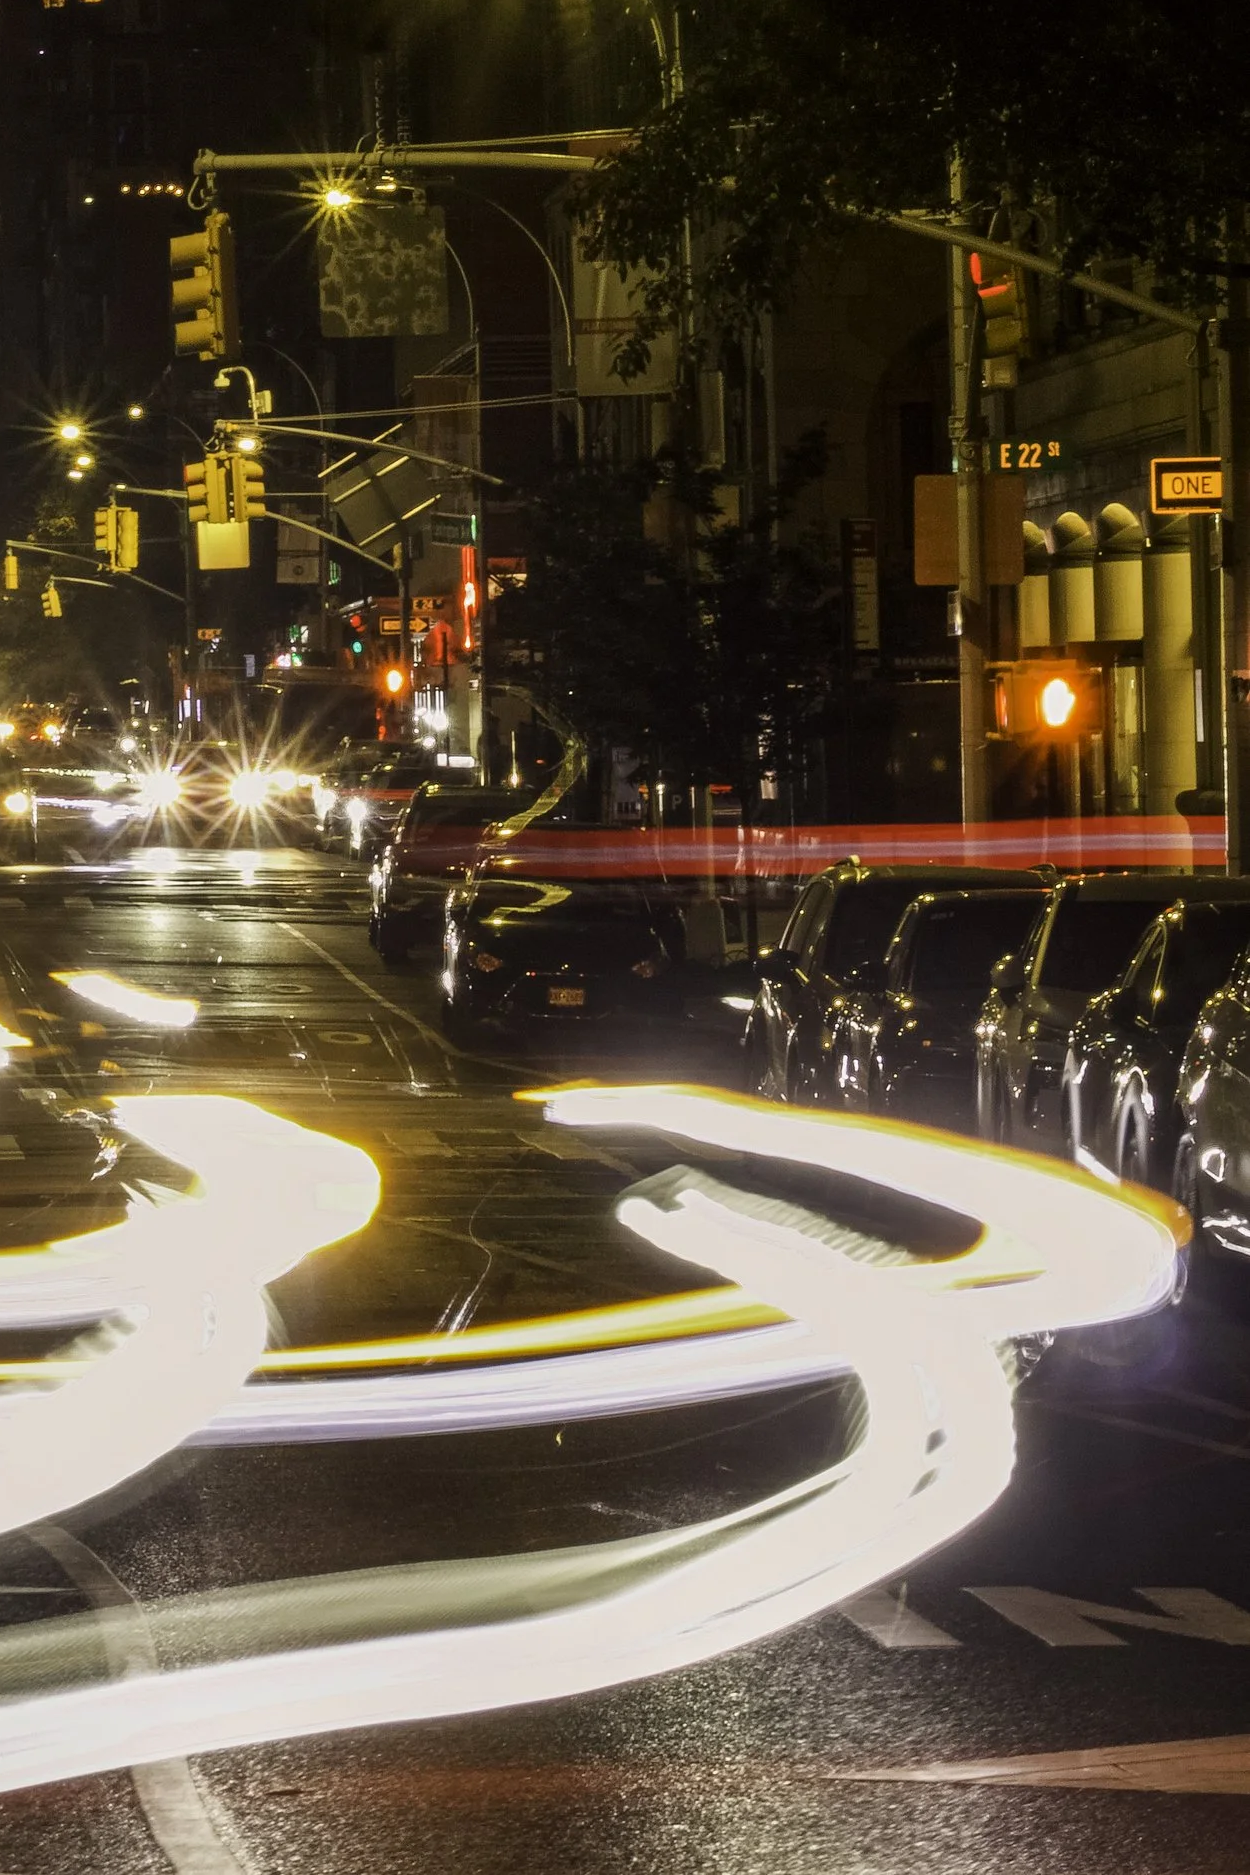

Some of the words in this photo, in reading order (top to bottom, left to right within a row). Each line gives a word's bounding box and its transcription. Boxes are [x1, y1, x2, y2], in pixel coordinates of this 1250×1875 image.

[1000, 443, 1012, 468] E
[1018, 443, 1042, 468] 22
[1171, 476, 1213, 495] ONE
